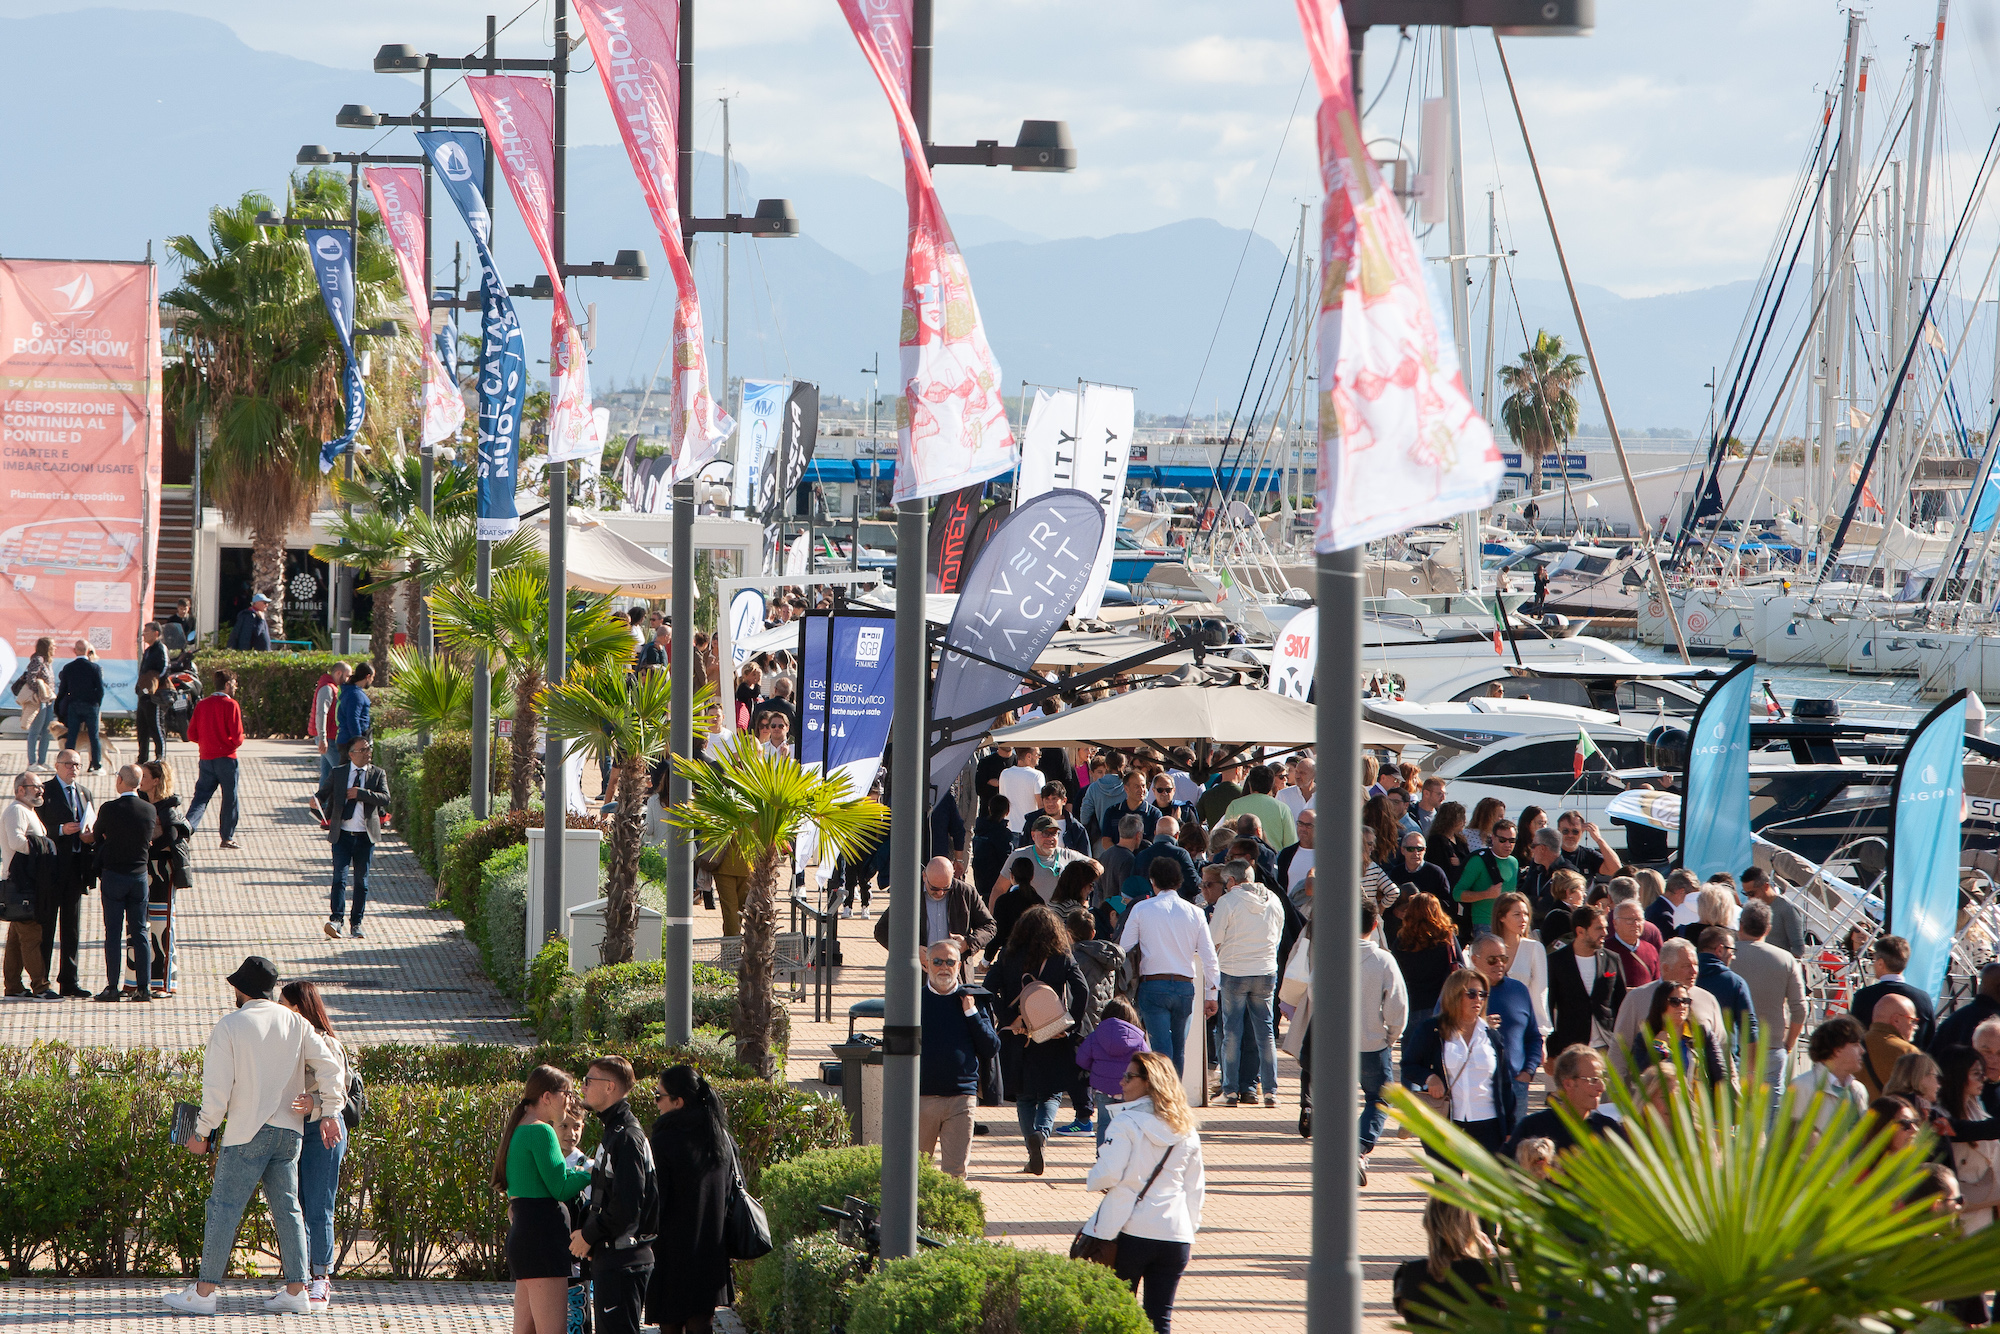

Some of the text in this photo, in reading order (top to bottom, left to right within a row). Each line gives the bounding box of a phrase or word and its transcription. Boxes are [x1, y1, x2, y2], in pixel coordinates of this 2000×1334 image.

[49, 321, 112, 340] Salerno
[13, 337, 129, 357] BOAT SHOW
[8, 379, 24, 388] 5-6
[33, 380, 57, 389] 12-13
[58, 381, 108, 390] Novembre
[110, 382, 134, 392] 2022
[3, 400, 115, 415] L'ESPOSIZIONE
[479, 402, 500, 420] E
[3, 414, 106, 430] CONTINUA AL
[495, 370, 519, 477] NUOVO
[3, 429, 82, 443] PONTILE D
[3, 447, 69, 459] CHARTER E
[754, 433, 762, 465] MARINE
[2, 461, 134, 474] IMBARCAZIONI USATE
[1099, 427, 1118, 505] NITY
[10, 489, 126, 502] Planimetria espositiva
[283, 601, 292, 610] LE
[1020, 618, 1055, 662] MARINA
[1053, 562, 1093, 616] CHARTER
[858, 641, 880, 656] SGB
[1284, 633, 1310, 660] 3M
[855, 660, 878, 668] FINANCE
[833, 682, 863, 693] LEASING E
[832, 694, 857, 704] CREDITO
[808, 703, 825, 711] Barc
